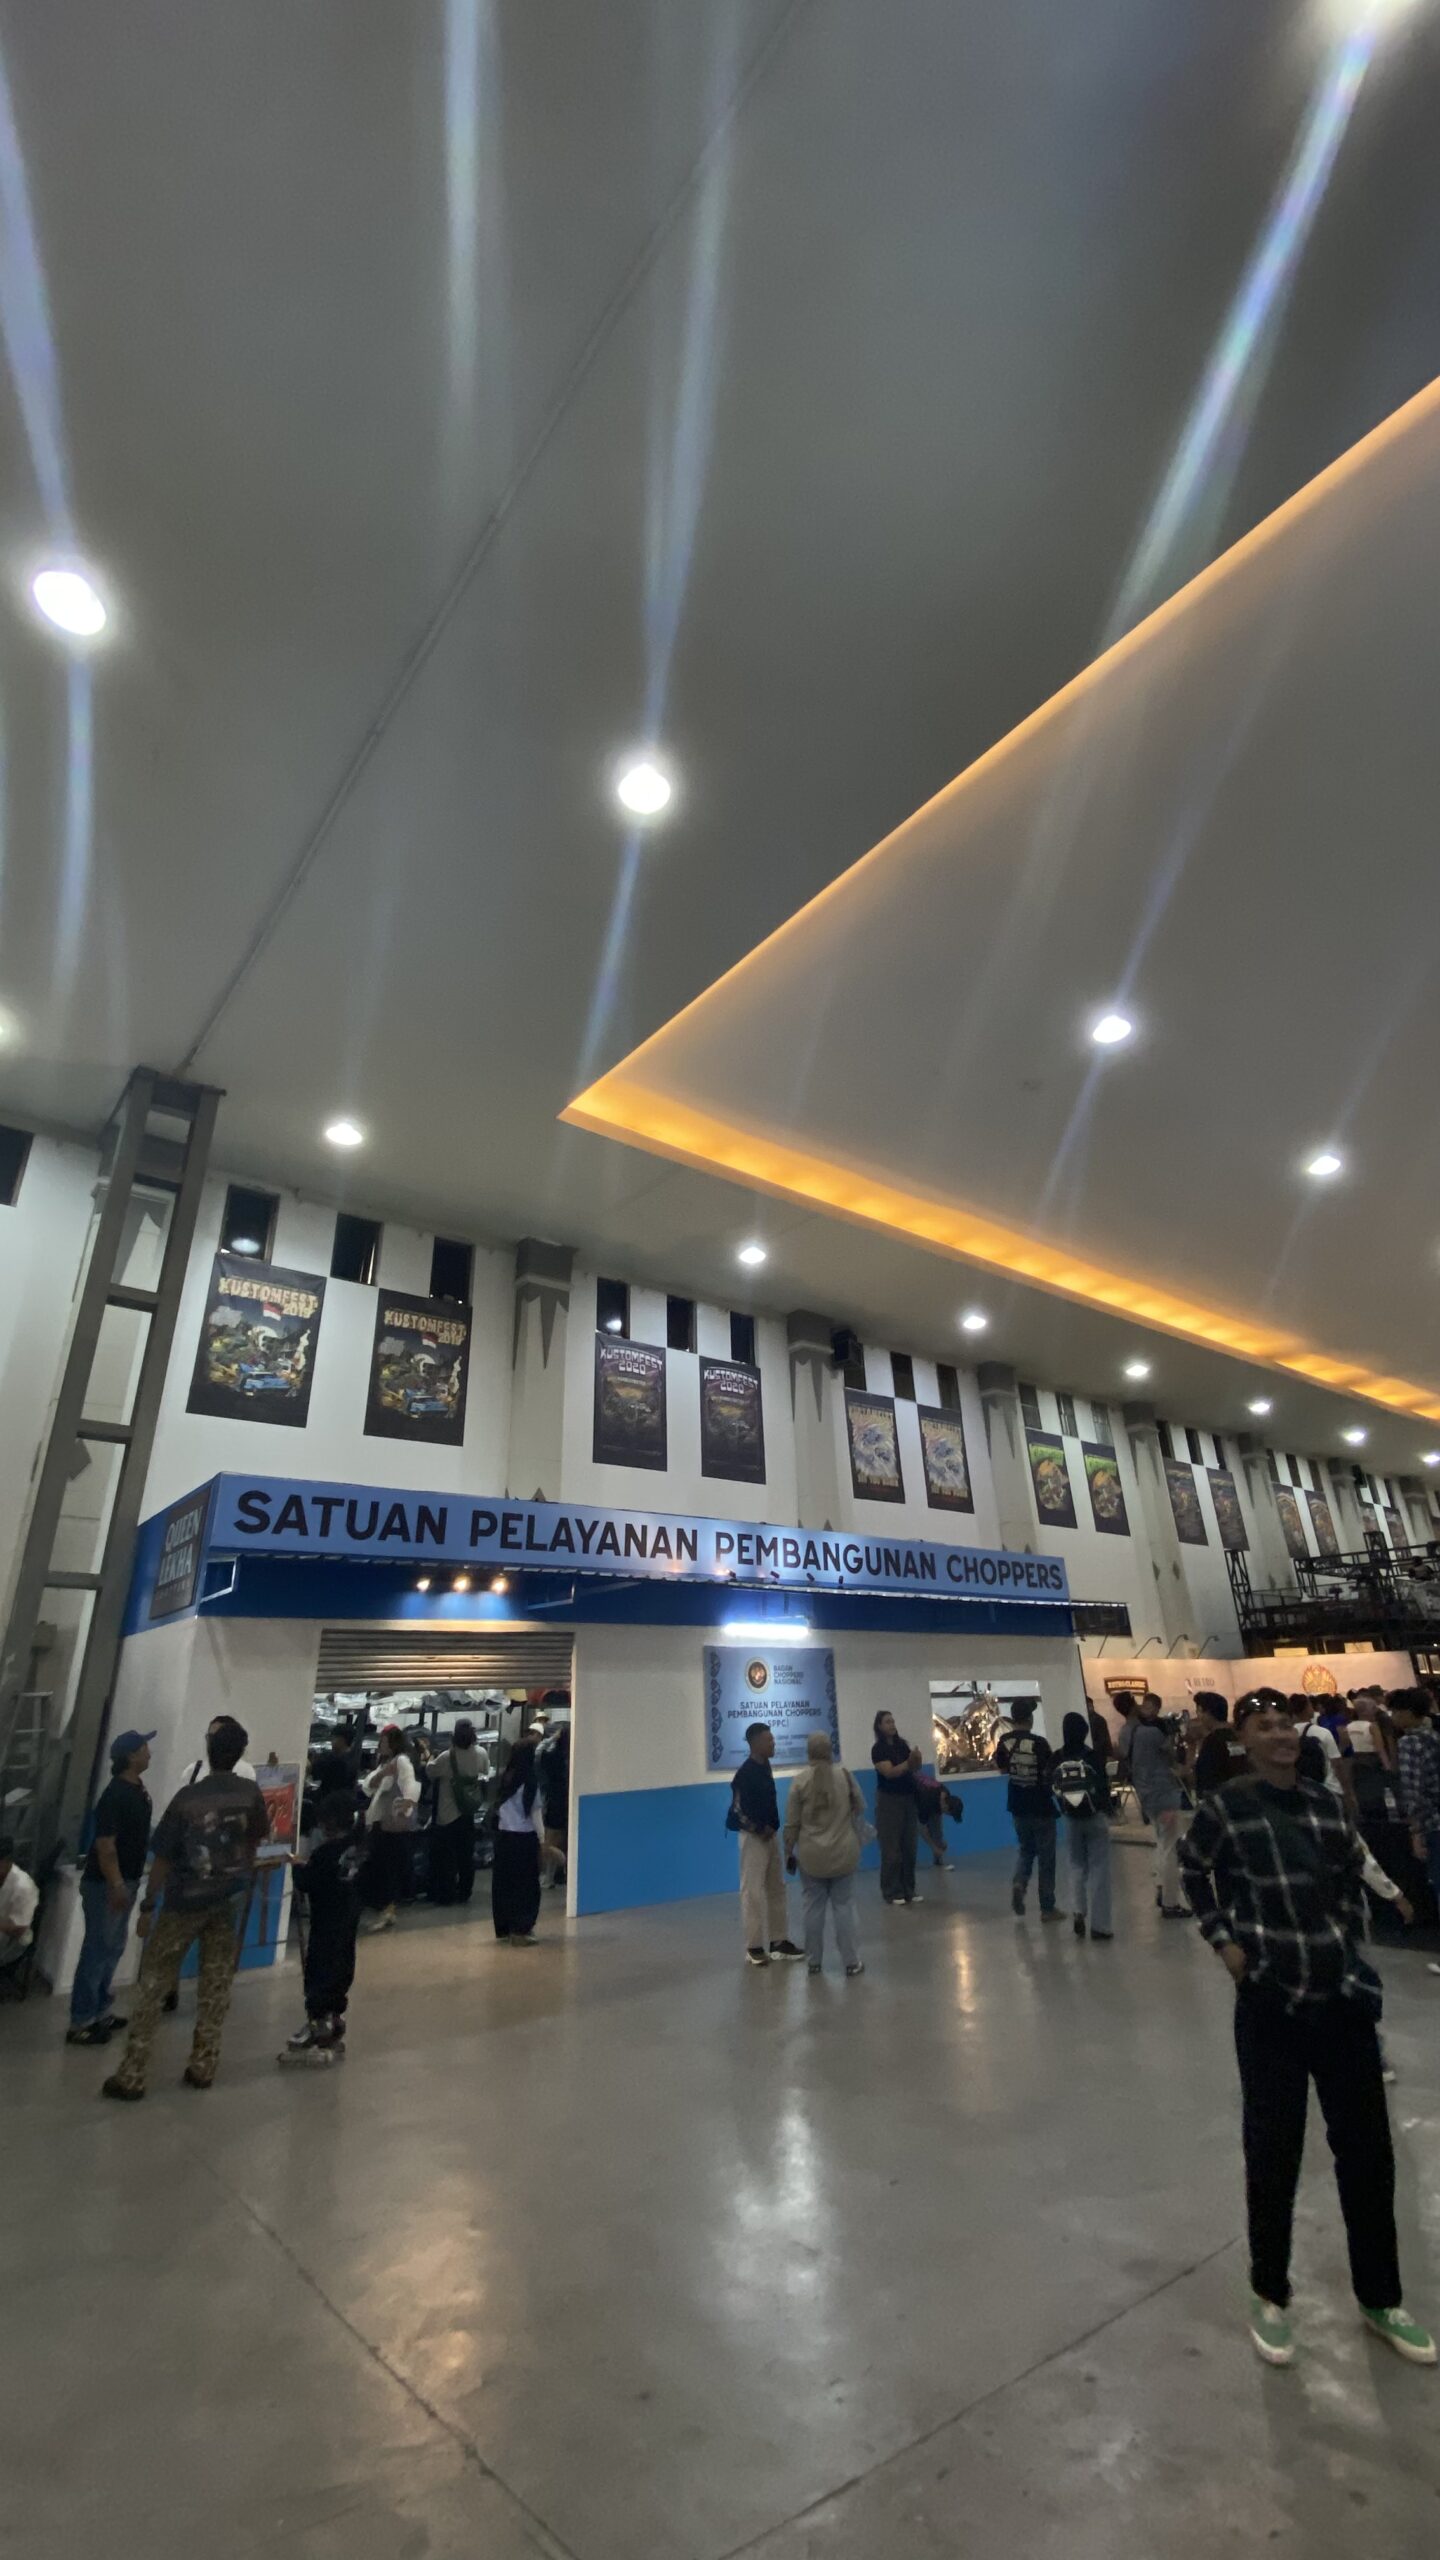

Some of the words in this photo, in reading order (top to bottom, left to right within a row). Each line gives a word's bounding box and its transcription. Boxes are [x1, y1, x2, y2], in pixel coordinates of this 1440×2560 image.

[218, 1277, 318, 1309] KUSTOMFEST
[384, 1310, 467, 1337] KUSTOMFEST
[600, 1348, 663, 1371] KUSTOMFEST
[619, 1361, 646, 1375] 2020
[704, 1369, 759, 1390] KUSTOMFEST
[720, 1382, 745, 1394] 2020
[233, 1490, 448, 1545] SATUAN
[469, 1510, 698, 1561] PELAYANAN
[715, 1532, 937, 1580] PEMBANGUNAN
[946, 1555, 1064, 1590] CHOPPERS
[727, 1710, 783, 1718] PEMBANGUNAN
[785, 1708, 822, 1717] CHOPPERS
[740, 1701, 768, 1709] SATUAN
[771, 1701, 810, 1709] PELAYANAN
